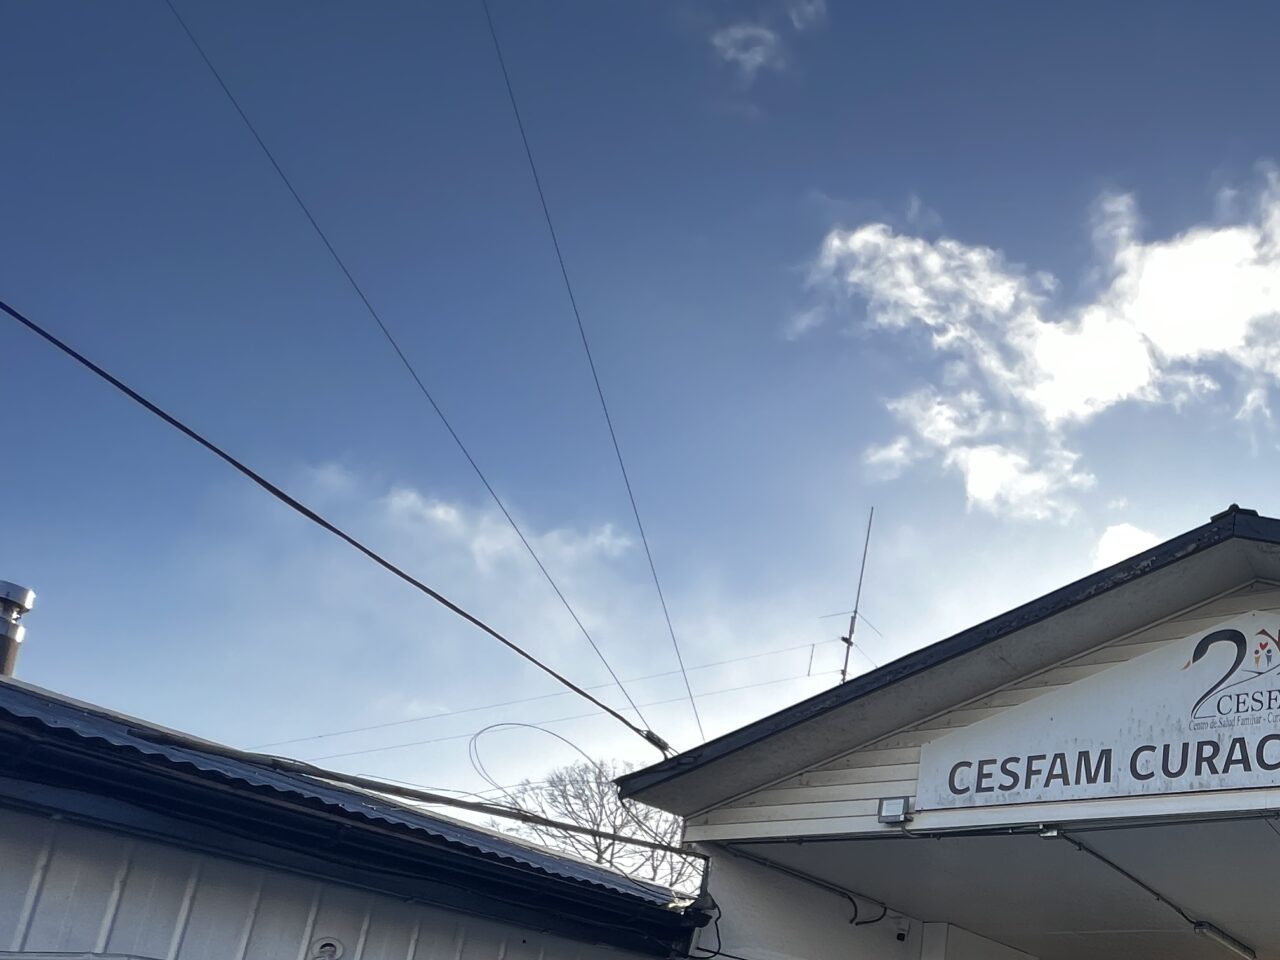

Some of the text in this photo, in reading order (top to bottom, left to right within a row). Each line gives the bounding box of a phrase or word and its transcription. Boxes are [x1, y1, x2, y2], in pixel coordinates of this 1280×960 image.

[1188, 720, 1209, 731] Centro
[1210, 718, 1218, 729] de
[1218, 716, 1235, 729] Salud
[1236, 714, 1262, 727] Familiar
[948, 748, 1113, 795] CESFAM
